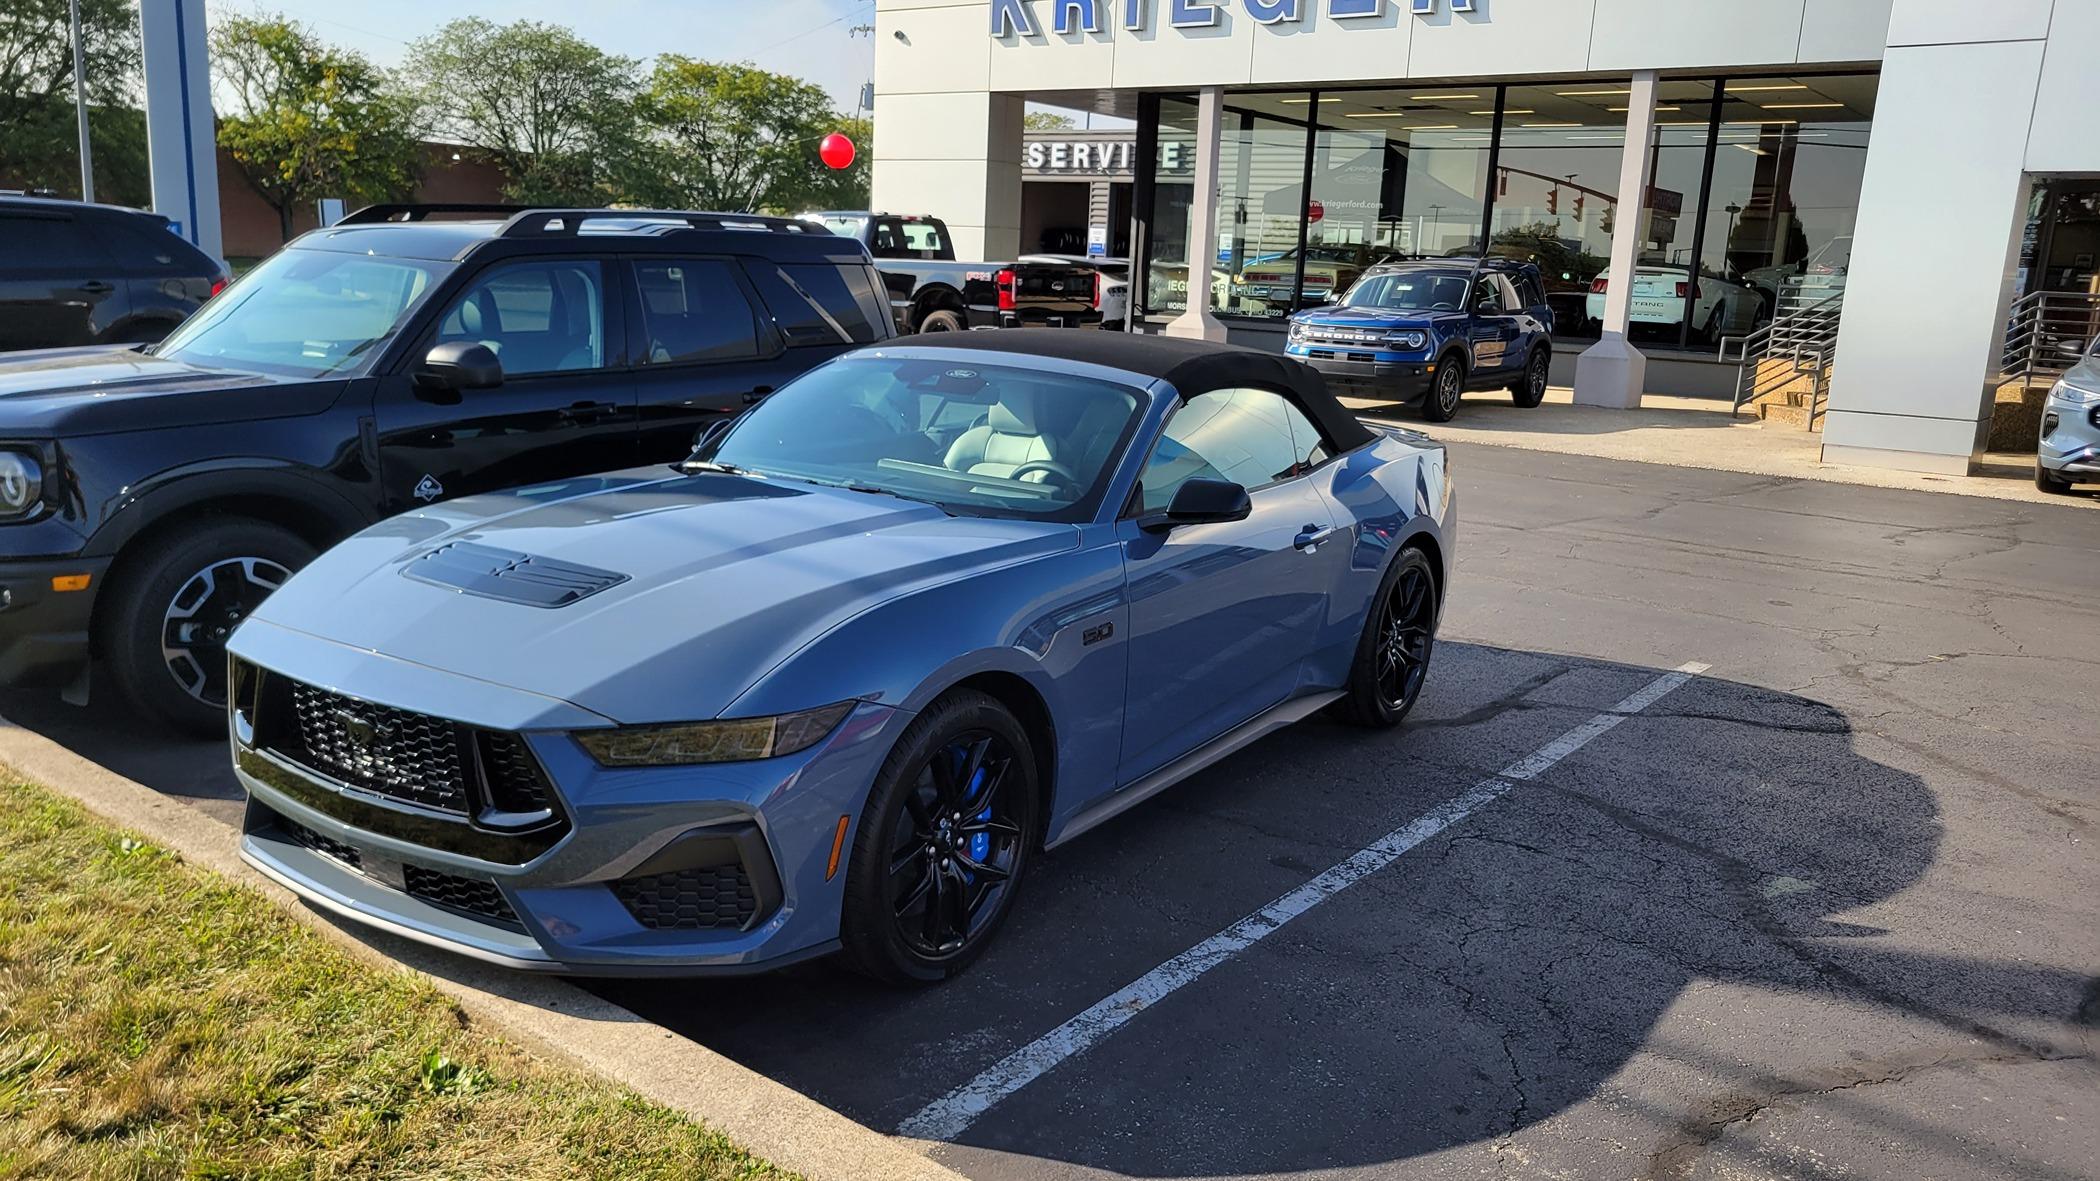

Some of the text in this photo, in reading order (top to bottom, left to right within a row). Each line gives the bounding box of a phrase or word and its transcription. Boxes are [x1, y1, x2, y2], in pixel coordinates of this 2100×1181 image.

[1028, 142, 1180, 169] SERVIE
[1309, 200, 1383, 209] ww.kriegerford.com
[1167, 302, 1186, 310] MORS
[1313, 332, 1377, 340] BRONCO
